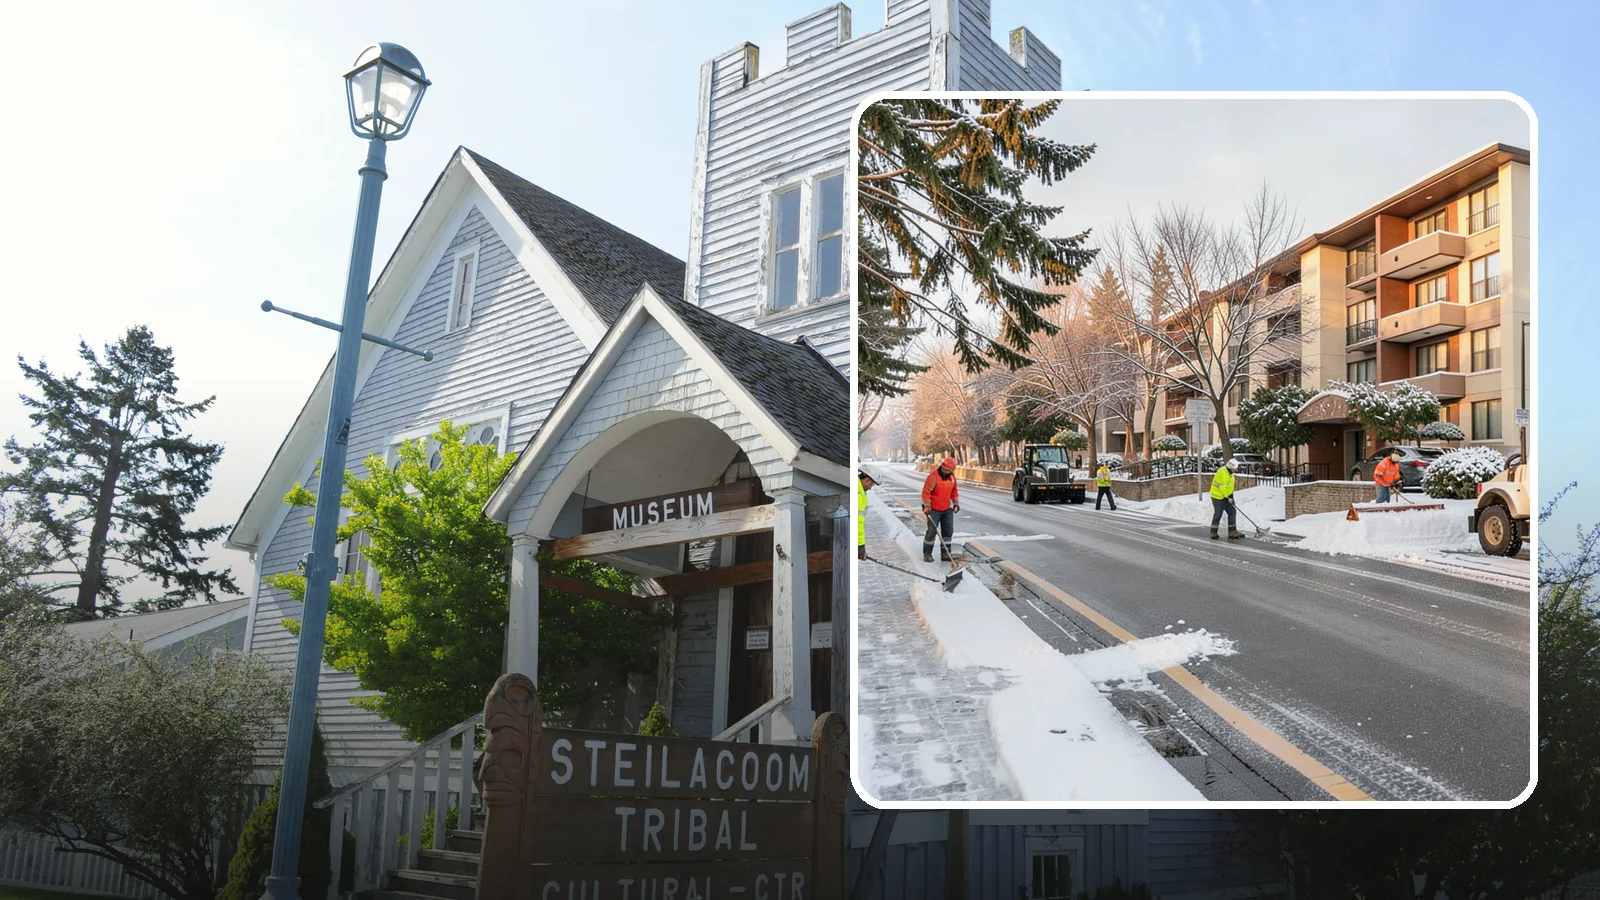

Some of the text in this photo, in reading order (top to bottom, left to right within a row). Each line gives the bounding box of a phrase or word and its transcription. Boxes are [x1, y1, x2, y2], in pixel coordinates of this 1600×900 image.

[613, 492, 713, 530] MUSEUM
[551, 739, 809, 792] STEILACOOM
[615, 807, 758, 852] TRIBAL
